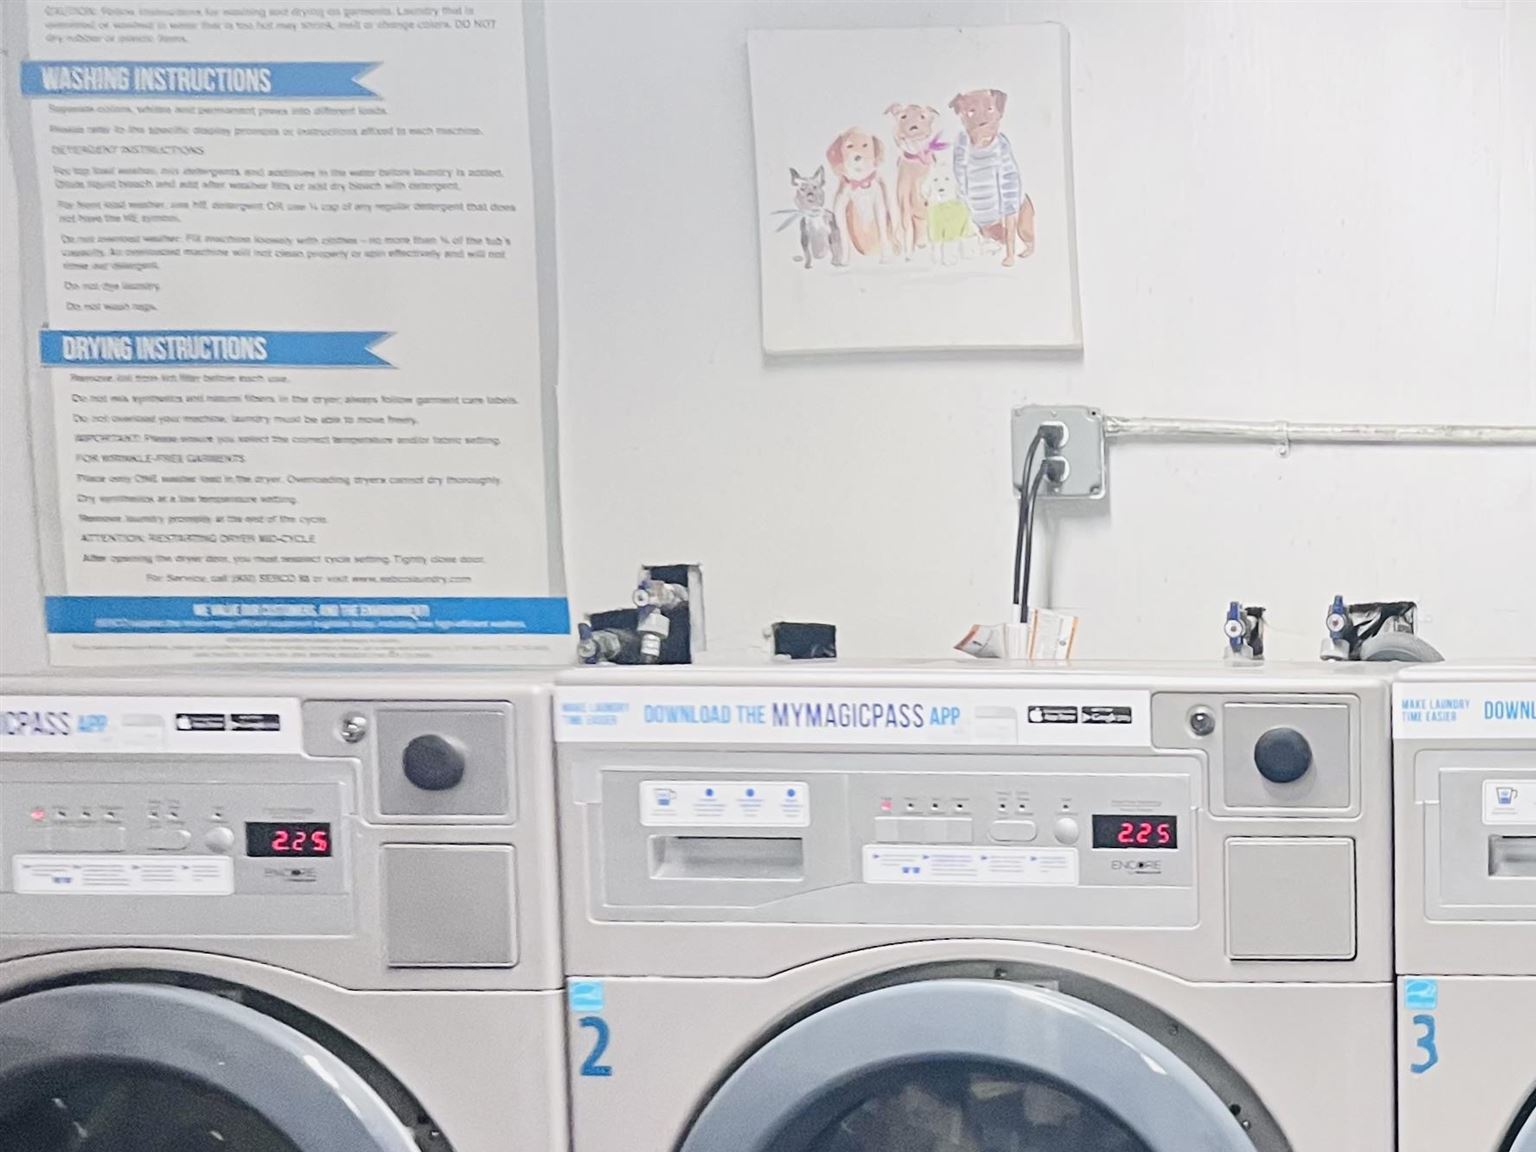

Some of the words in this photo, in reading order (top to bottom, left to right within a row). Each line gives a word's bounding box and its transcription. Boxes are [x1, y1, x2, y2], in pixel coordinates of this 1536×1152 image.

[473, 18, 497, 28] NOT
[41, 66, 129, 91] WASHING
[134, 67, 272, 93] INSTRUCTIONS
[62, 335, 132, 361] DRYING
[136, 336, 268, 361] INSTRUCTIONS
[644, 705, 731, 724] DOWNLOAD
[736, 705, 766, 724] THE
[772, 703, 924, 728] MYMAGICPASS
[929, 706, 960, 725] APP
[1401, 699, 1426, 710] MAKE
[1430, 699, 1470, 710] LAUNDRY
[1402, 711, 1422, 722] TIME
[1426, 711, 1457, 722] EASIER
[578, 1016, 612, 1076] 2
[1410, 1014, 1438, 1074] 3
